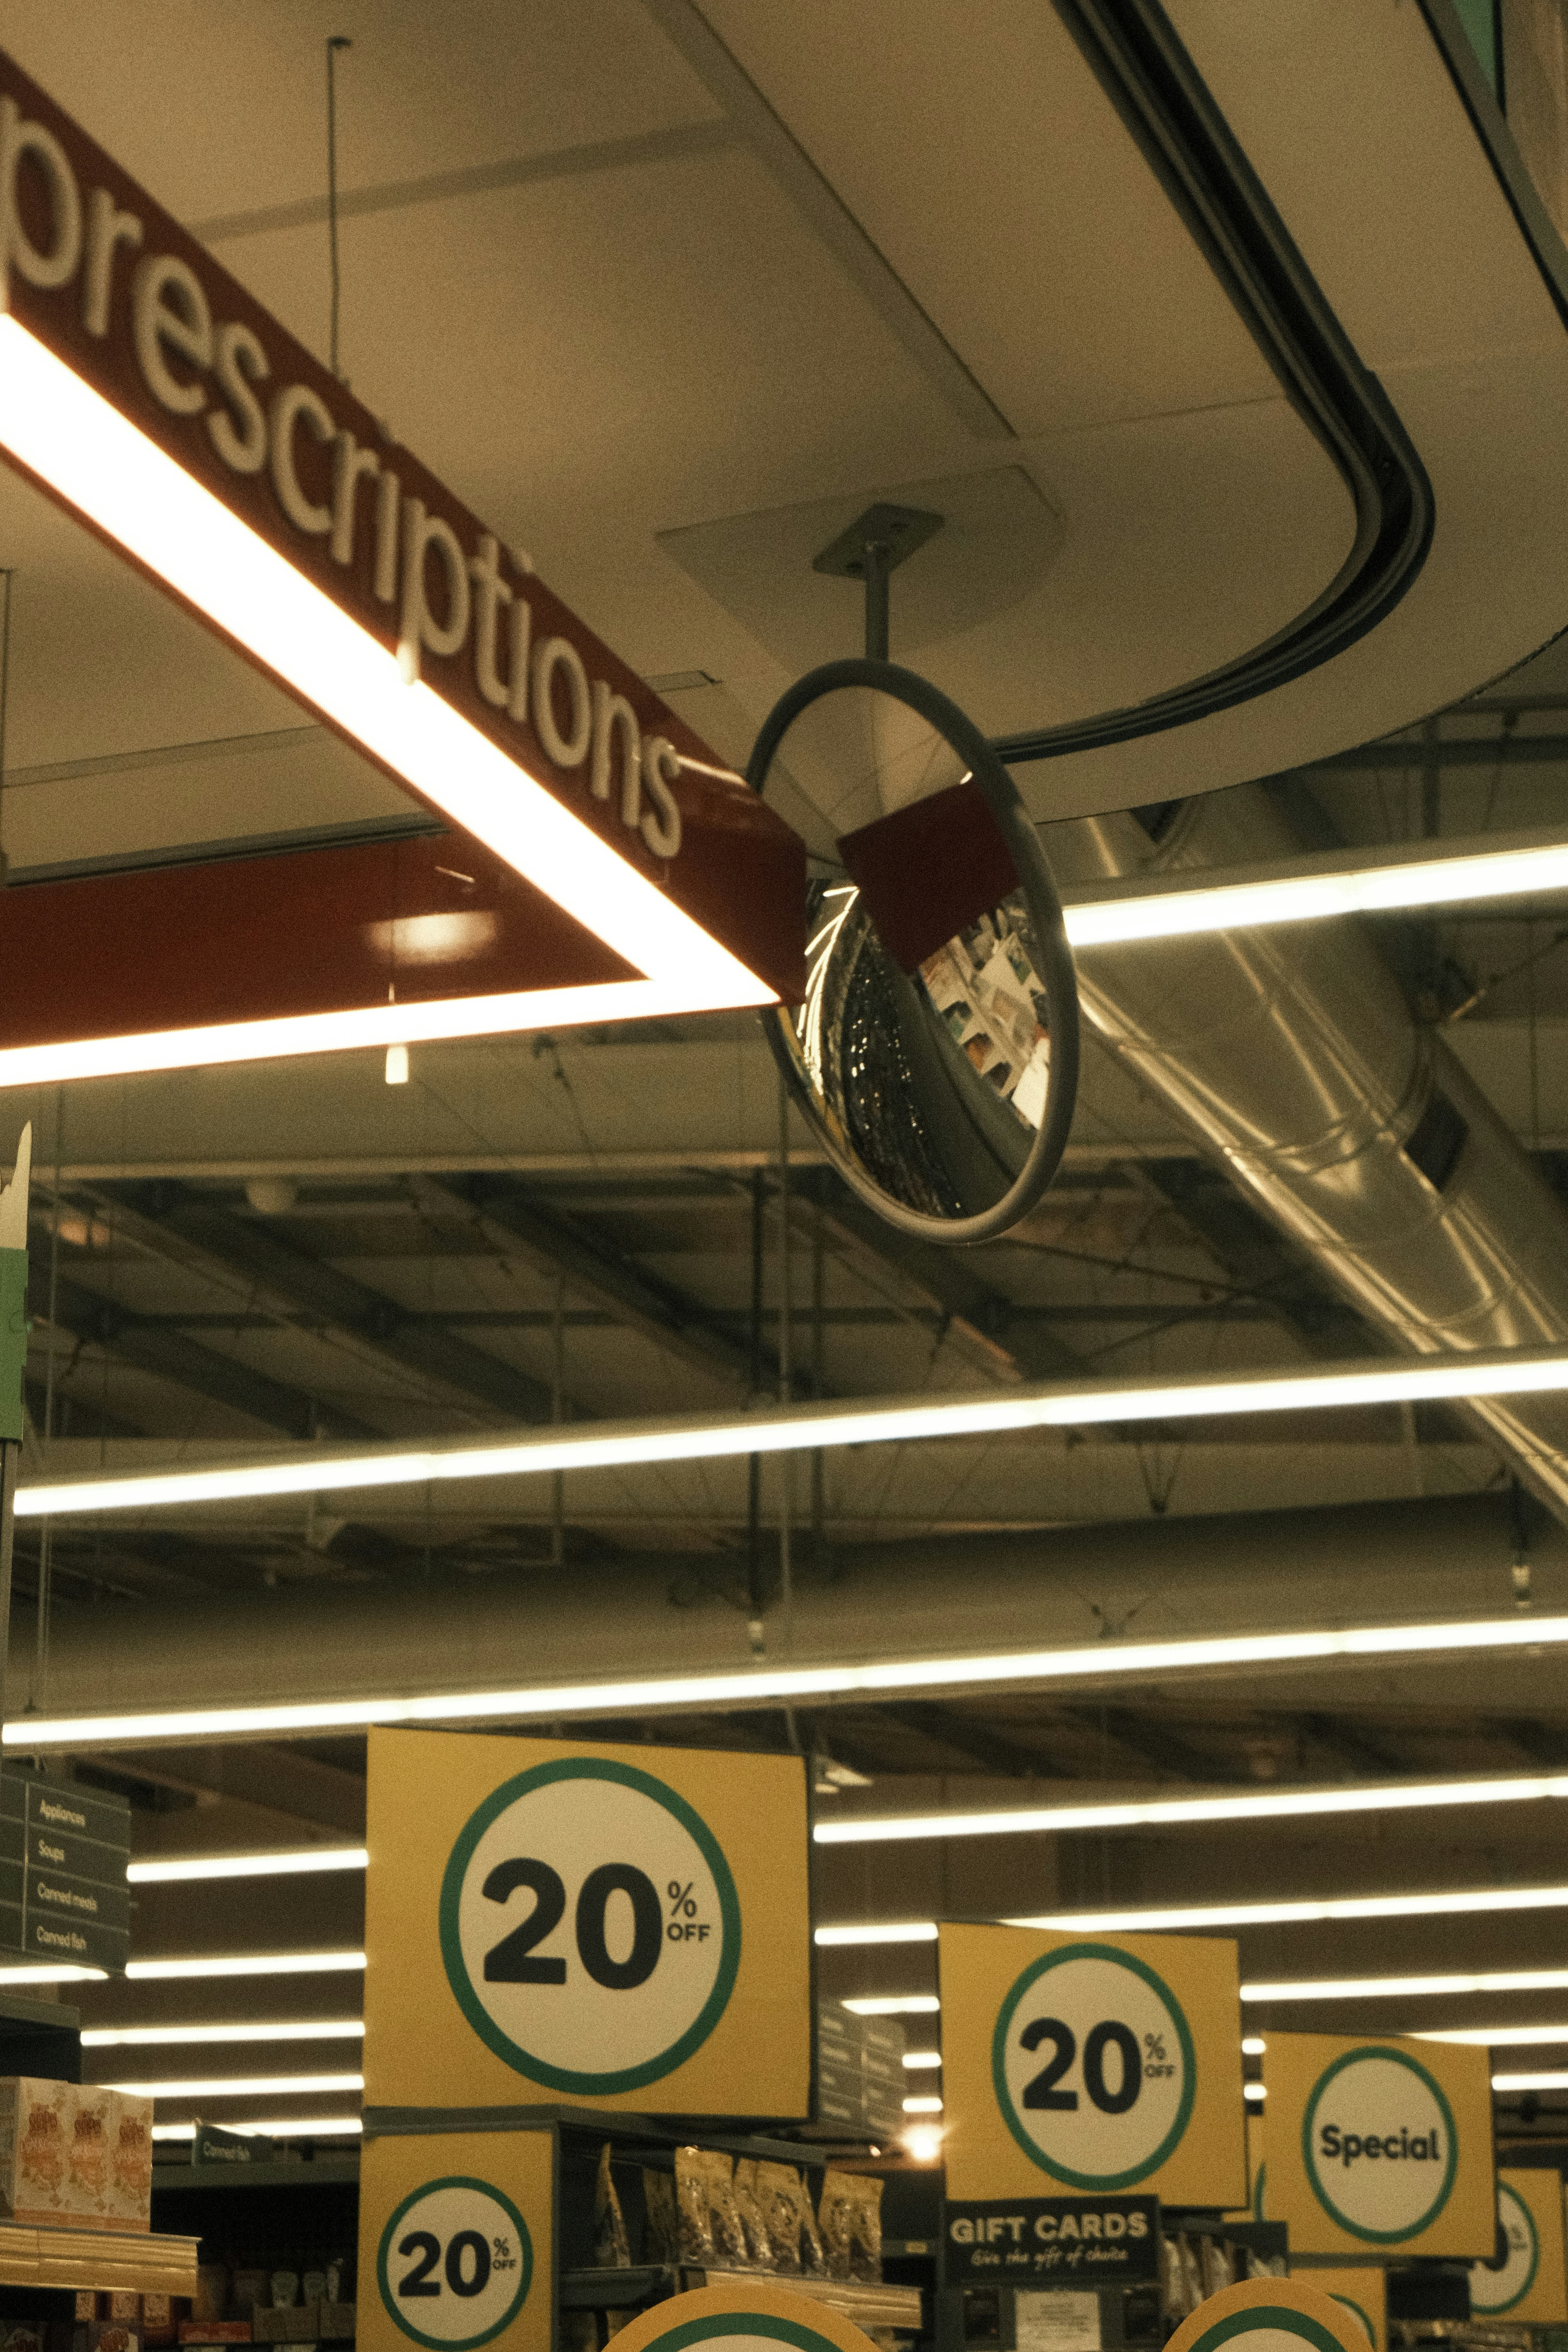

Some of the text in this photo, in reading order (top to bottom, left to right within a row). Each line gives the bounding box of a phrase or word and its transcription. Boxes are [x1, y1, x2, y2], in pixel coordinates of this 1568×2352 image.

[39, 1799, 86, 1828] Appliances
[38, 1839, 65, 1862] Soups
[37, 1882, 71, 1906] Canned
[36, 1925, 70, 1948] Canned
[482, 1857, 663, 1990] 20
[667, 1923, 710, 1942] OFF
[1020, 2017, 1142, 2114] 20
[1144, 2064, 1175, 2078] OFF
[1320, 2124, 1441, 2168] Special
[949, 2212, 1148, 2243] GIFT CARDS
[398, 2230, 491, 2297] 20
[493, 2259, 517, 2270] OFF
[1034, 2244, 1061, 2271] gift
[1066, 2244, 1084, 2268] of
